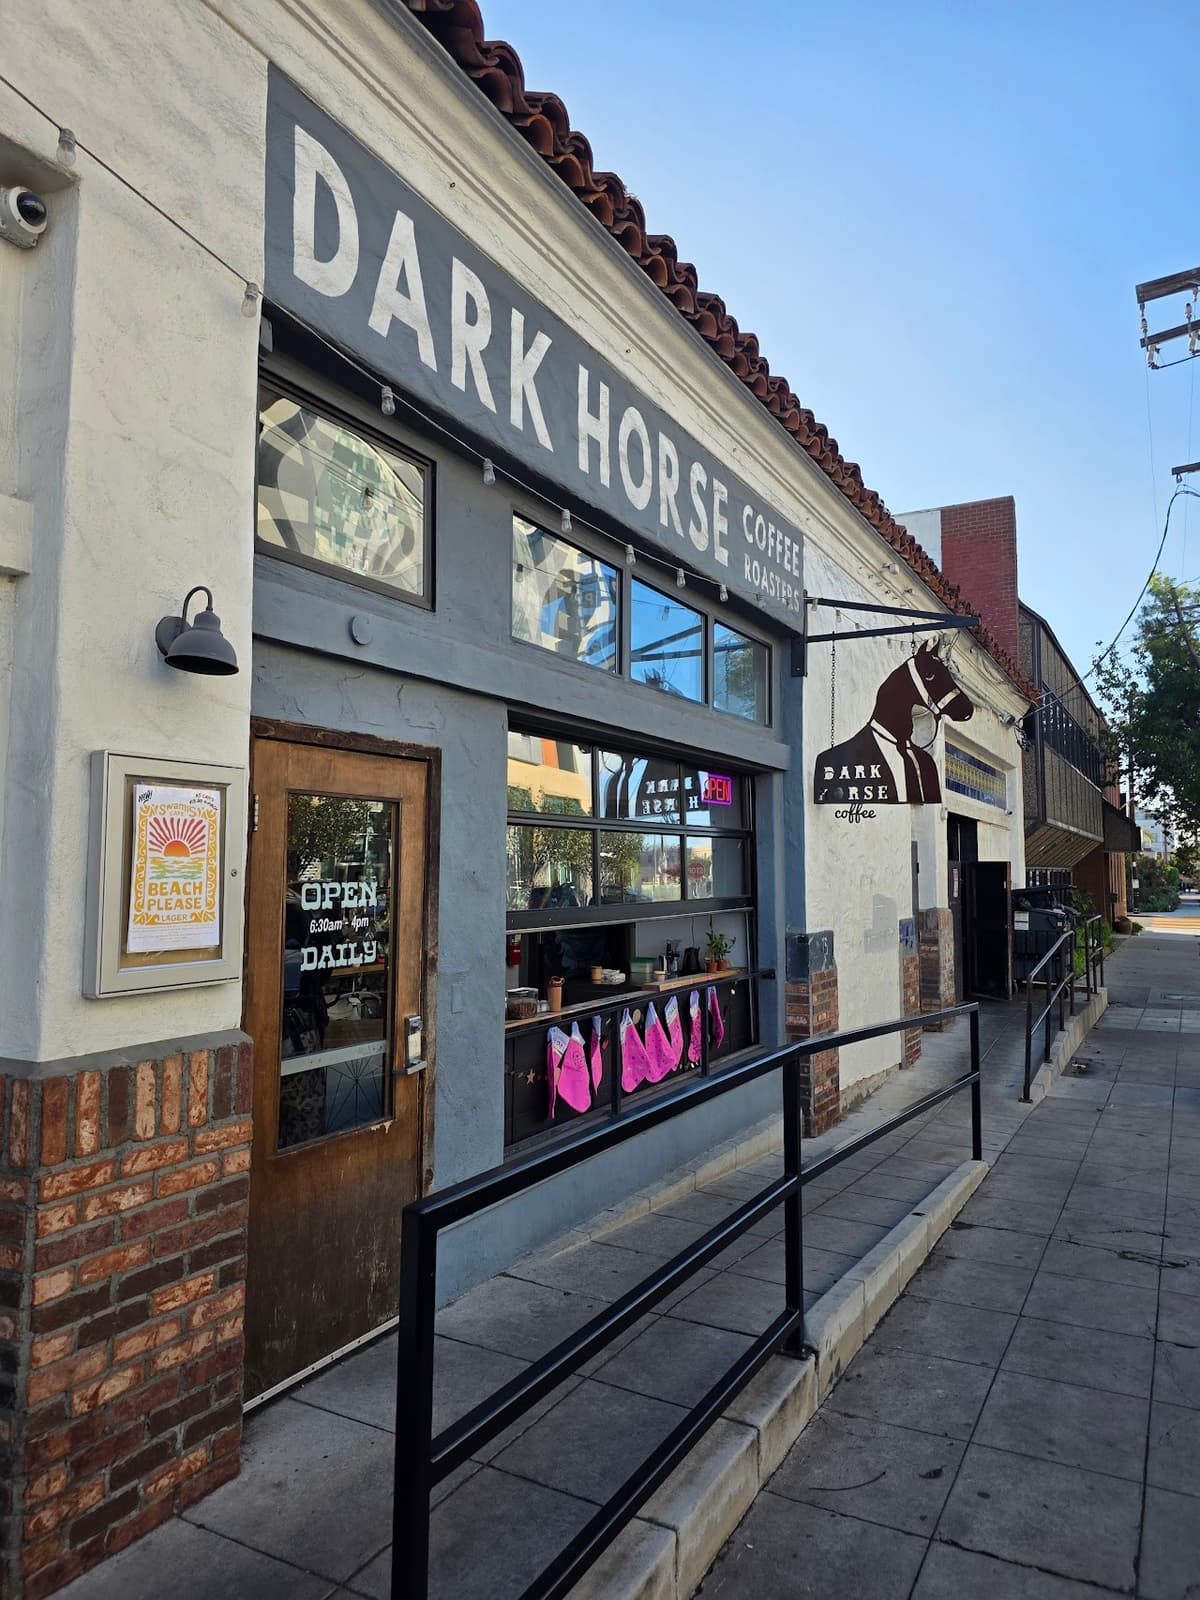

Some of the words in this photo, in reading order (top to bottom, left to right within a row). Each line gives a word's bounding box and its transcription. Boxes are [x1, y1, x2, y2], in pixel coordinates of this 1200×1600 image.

[293, 124, 554, 452] DARK
[577, 364, 729, 567] HORSE
[742, 504, 800, 577] COFFEE
[744, 553, 800, 612] ROASTERS
[823, 764, 882, 780] DARK
[834, 803, 877, 823] coffee
[148, 881, 203, 896] BEACH
[300, 881, 378, 911] OPEN
[147, 897, 202, 911] PLEASE
[161, 914, 188, 922] LAGER
[309, 919, 343, 933] 6:30am
[351, 915, 369, 931] 4pm
[300, 940, 378, 972] DAILY
